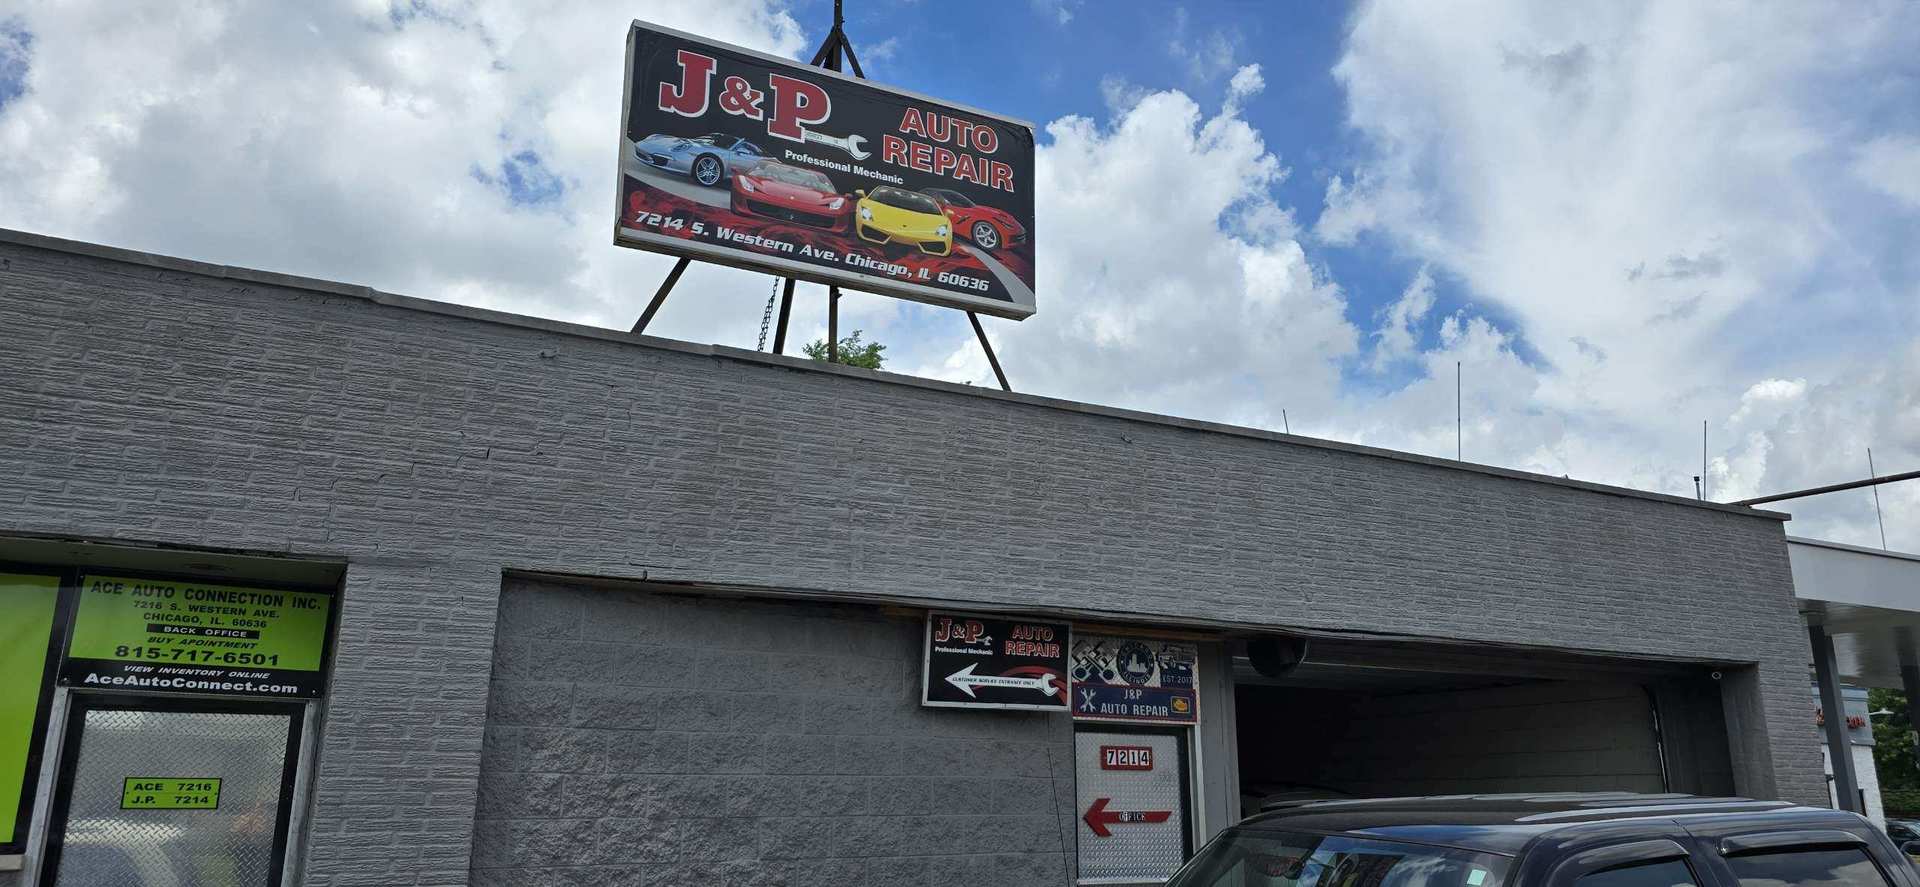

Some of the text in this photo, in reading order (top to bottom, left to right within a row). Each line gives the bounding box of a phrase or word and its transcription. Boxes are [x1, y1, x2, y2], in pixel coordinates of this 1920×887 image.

[658, 49, 832, 143] J&P
[899, 107, 999, 154] AUTO
[785, 149, 904, 185] Professional Mechanic
[882, 134, 1014, 192] REPAIR
[635, 211, 990, 292] 7214 S. Western Ave. Chicago, IL 60636
[91, 581, 321, 610] ACE AUTO CONNECTION INC.
[170, 602, 181, 611] S.
[188, 604, 247, 616] WESTERN
[253, 609, 280, 618] AVE.
[143, 612, 267, 629] CHICAGO, IL. 60636
[163, 626, 248, 638] BACK OFFICE
[935, 618, 984, 644] J&P
[1012, 624, 1054, 642] AUTO
[147, 636, 258, 650] BUY APOINTMENT
[935, 646, 994, 656] Professional Mechanic
[1005, 640, 1060, 658] REPAIR
[115, 645, 279, 667] 815-717-6501
[124, 665, 271, 680] VIEW INVENTORY ONLINE
[84, 672, 298, 694] AceAutoConnect.com
[1123, 688, 1142, 700] J&P
[1100, 702, 1168, 717] AUTO REPAIR
[1107, 750, 1149, 765] 7214
[134, 782, 211, 791] ACE 7216
[131, 796, 209, 804] J.P. 7214
